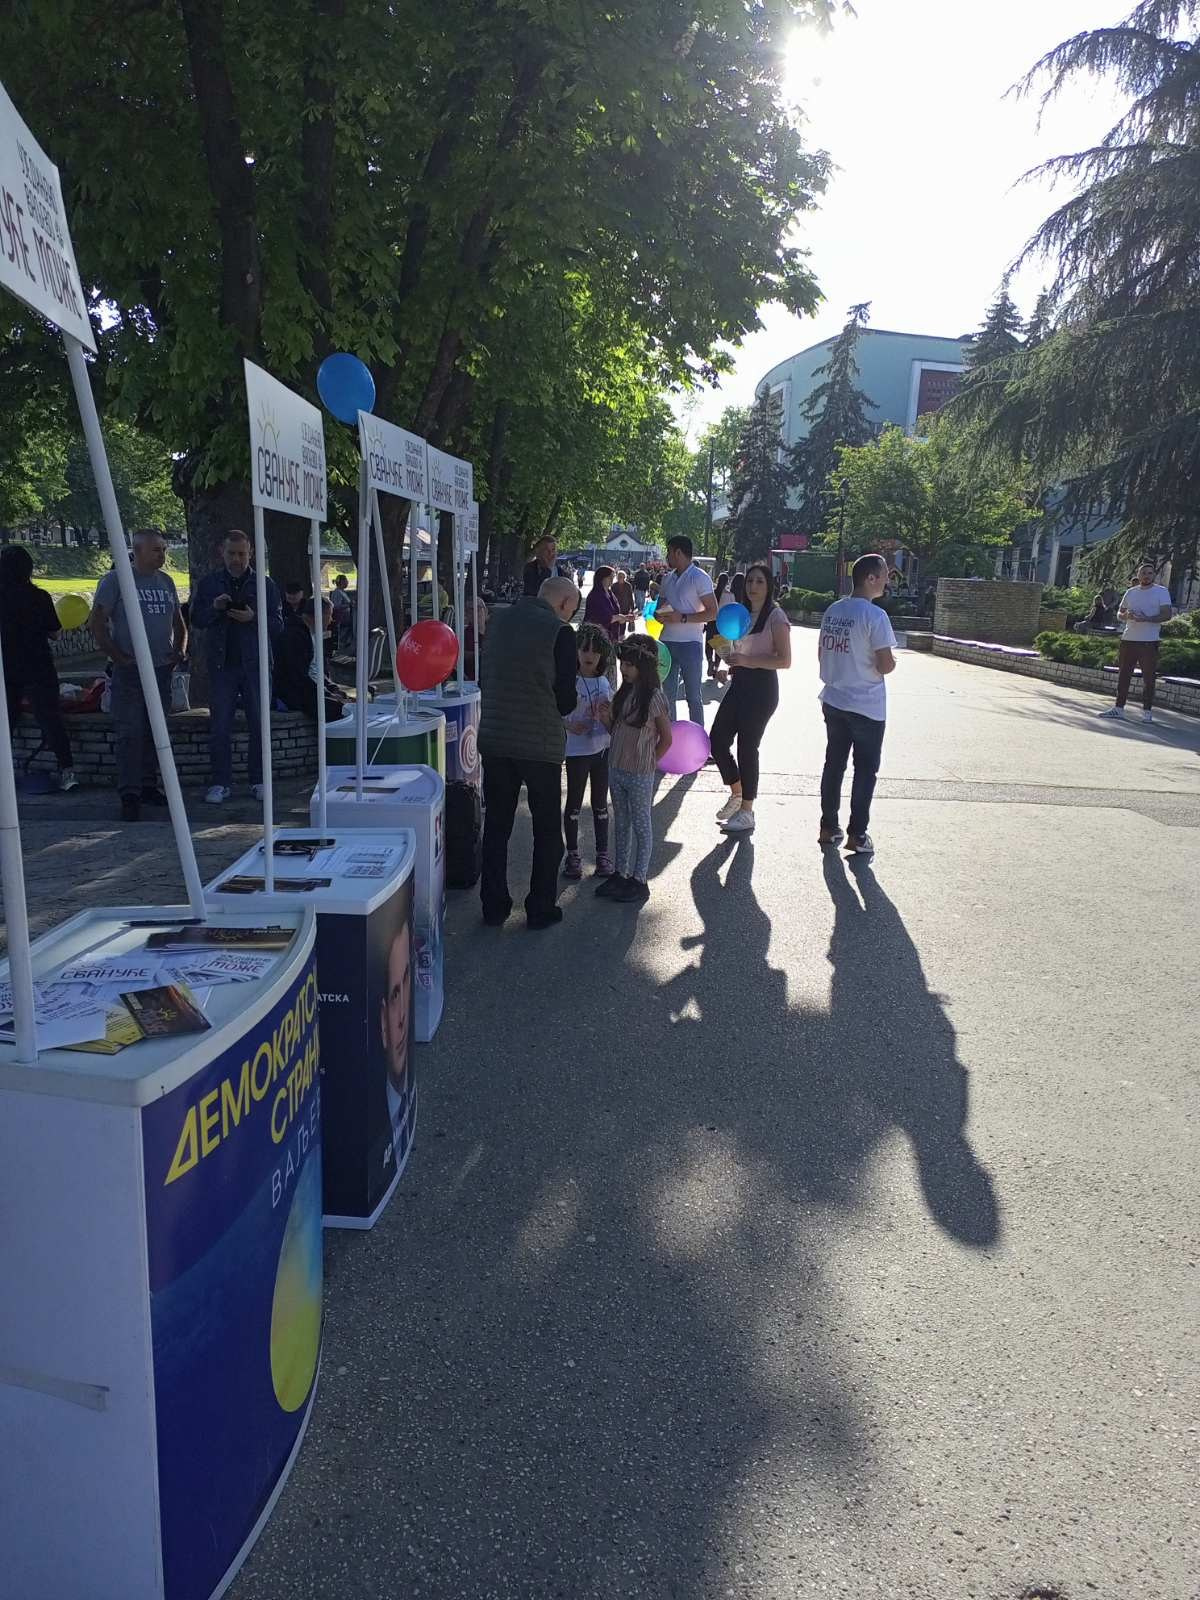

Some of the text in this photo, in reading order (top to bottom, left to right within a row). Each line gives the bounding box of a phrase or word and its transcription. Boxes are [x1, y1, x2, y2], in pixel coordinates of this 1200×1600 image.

[0, 184, 83, 320] УЋЕ МОЖЕ
[257, 446, 301, 505] СВАНУЋЕ
[303, 469, 324, 513] МОЖЕ
[60, 967, 151, 980] СВАНУЋЕ
[207, 960, 266, 975] МОЖЕ
[316, 993, 350, 1003] АТСКА
[271, 1024, 320, 1144] СТРАН
